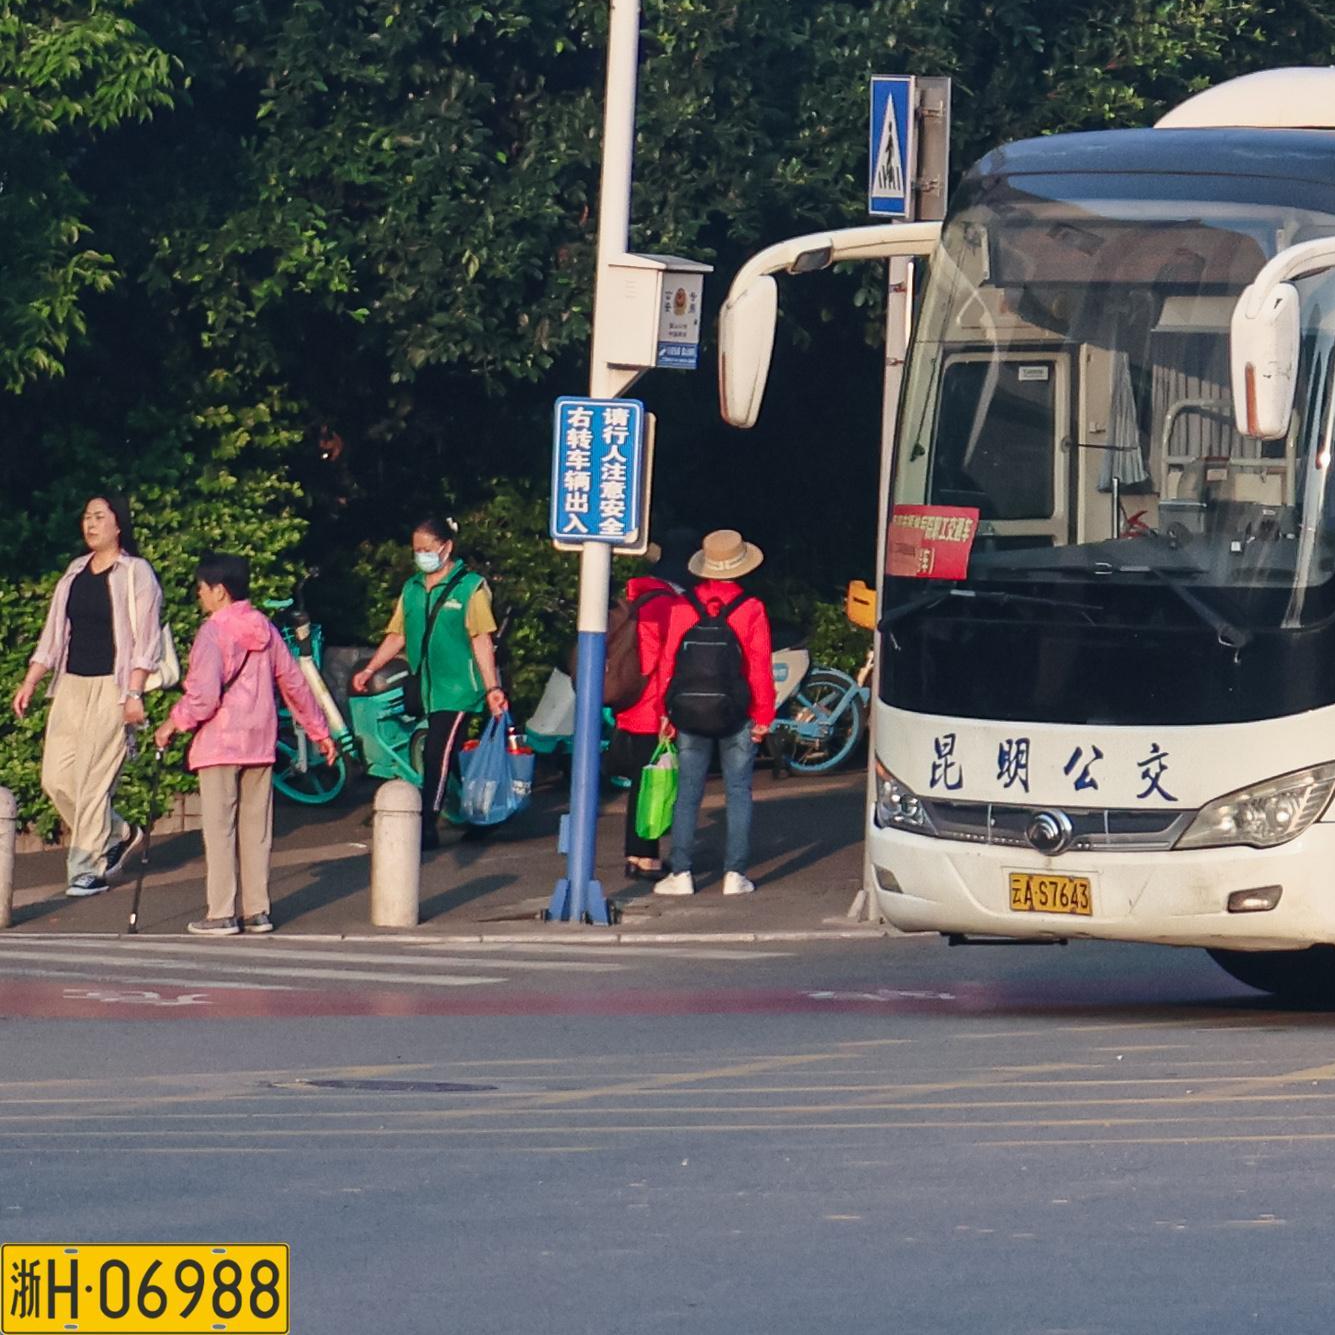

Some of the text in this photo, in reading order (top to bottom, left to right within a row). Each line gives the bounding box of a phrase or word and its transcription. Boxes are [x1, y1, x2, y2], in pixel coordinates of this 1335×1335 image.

[563, 407, 593, 533] 右转车辆出入
[599, 408, 629, 535] 请行人注意安全
[929, 732, 1179, 802] 昆明公交
